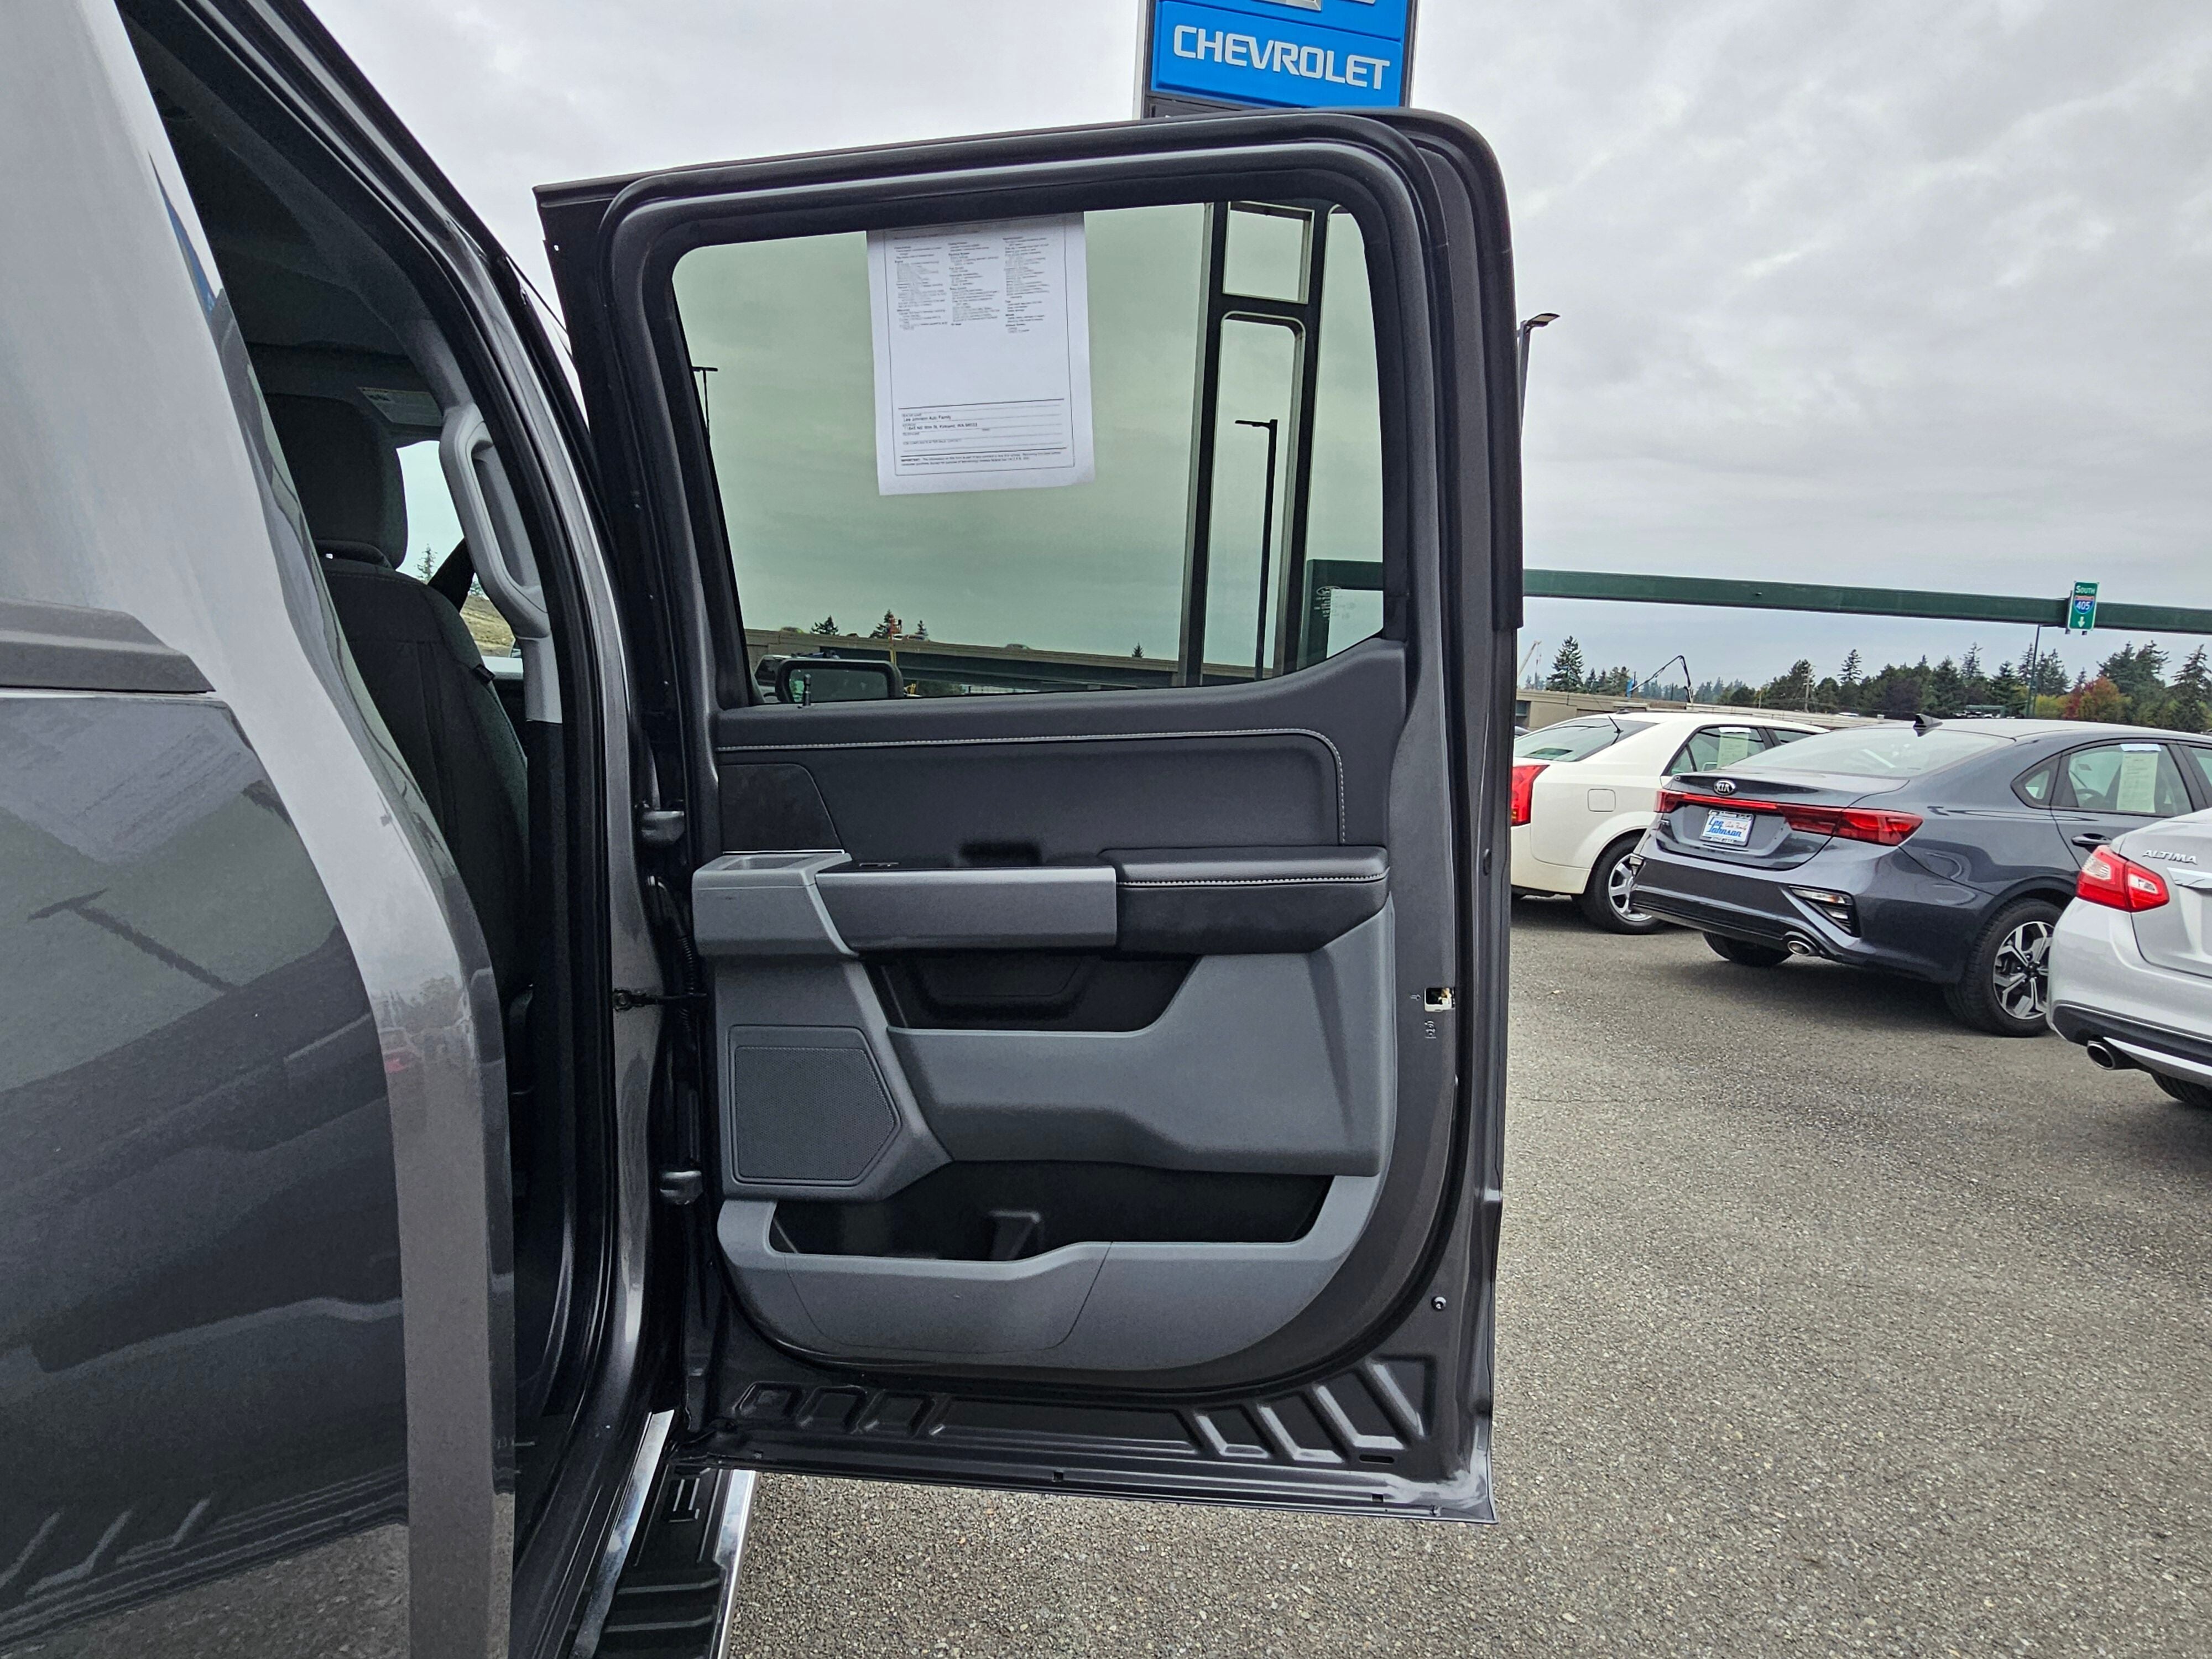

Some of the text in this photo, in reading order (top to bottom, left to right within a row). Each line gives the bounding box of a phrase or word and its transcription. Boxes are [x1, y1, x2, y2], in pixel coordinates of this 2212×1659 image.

[1173, 24, 1390, 90] CHEVROLET
[2076, 601, 2090, 610] 405
[1709, 816, 1724, 826] Lee
[1707, 824, 1742, 837] Johnson
[2142, 849, 2197, 865] ALTIMA
